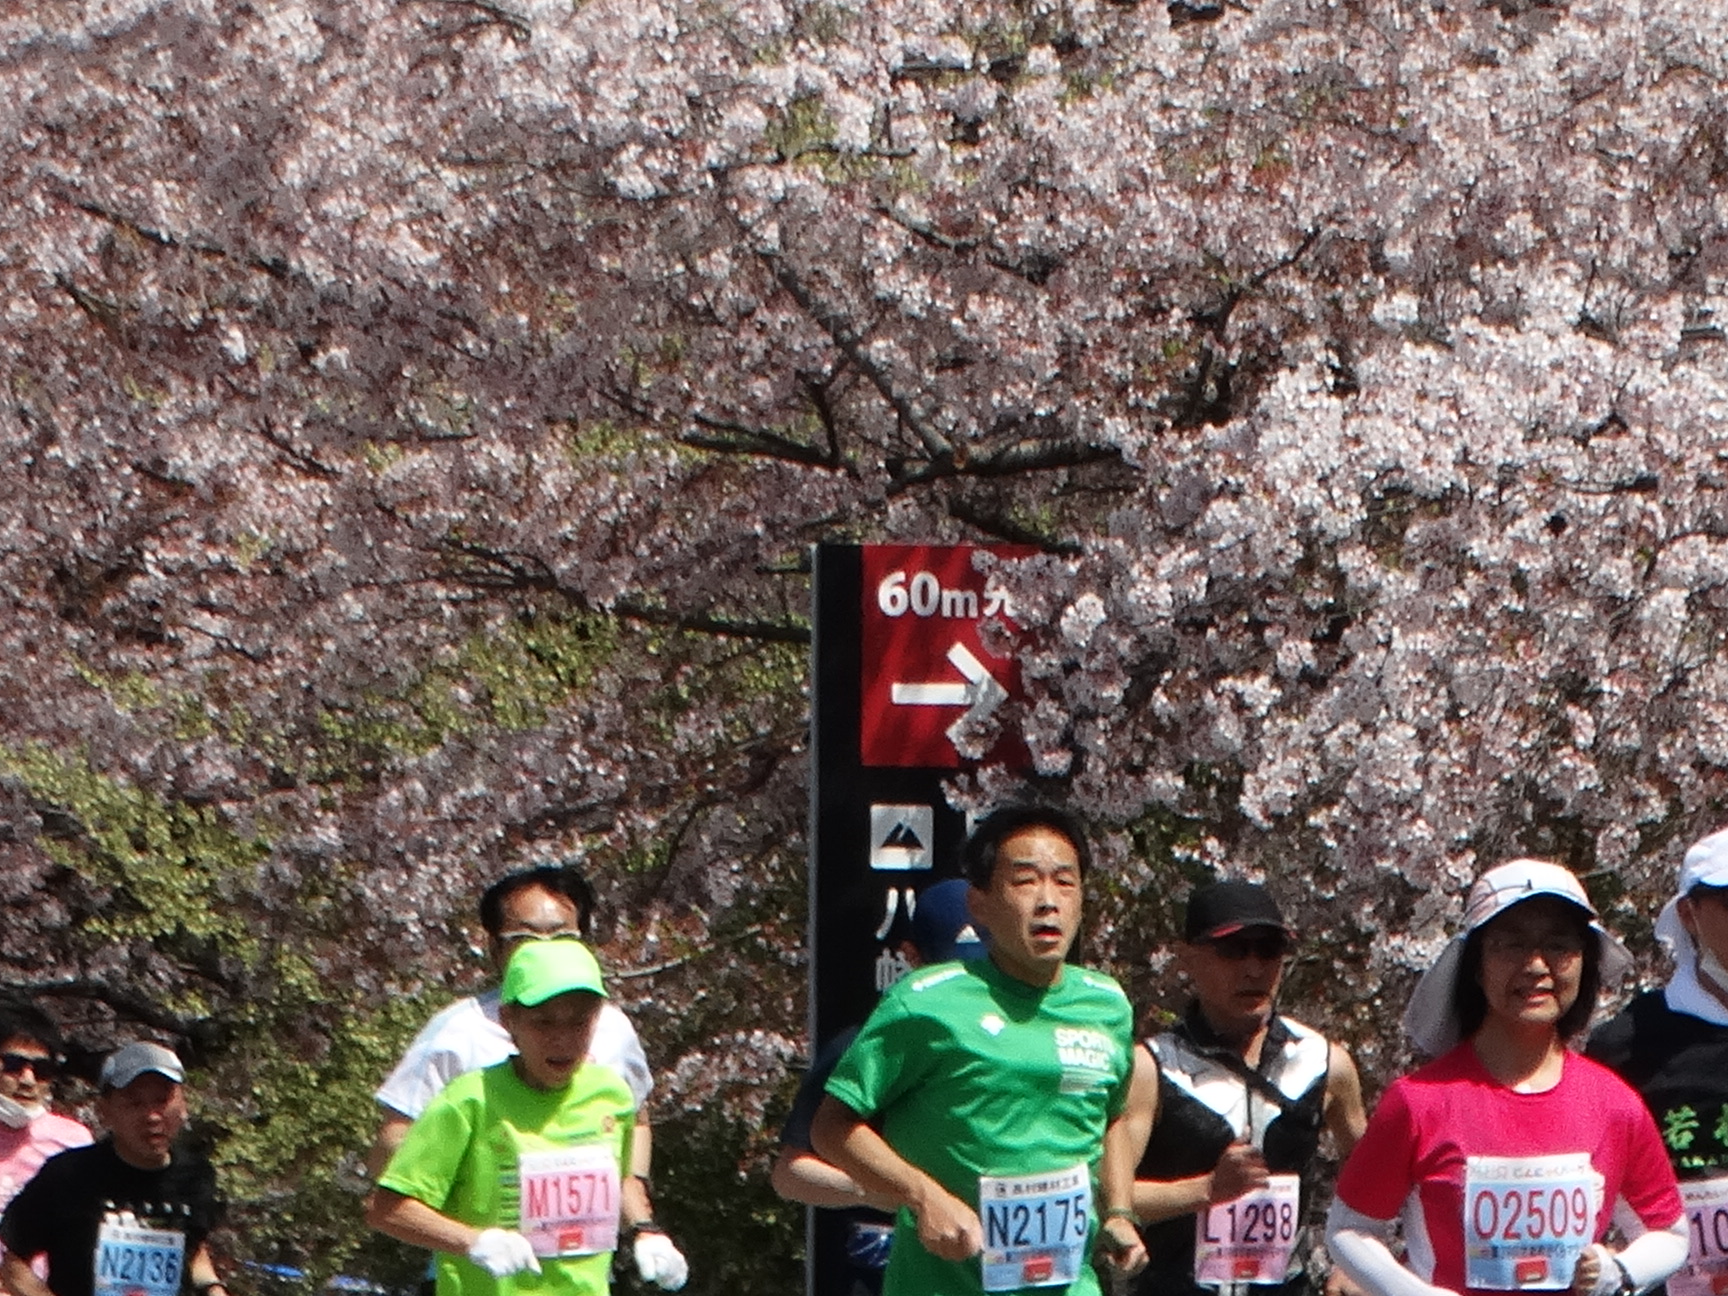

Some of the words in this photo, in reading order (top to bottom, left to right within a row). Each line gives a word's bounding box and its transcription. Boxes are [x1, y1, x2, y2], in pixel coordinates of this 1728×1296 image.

[527, 1173, 610, 1219] M1571
[987, 1193, 1087, 1249] N2175
[1203, 1202, 1292, 1244] L1298
[100, 1244, 178, 1284] N2136
